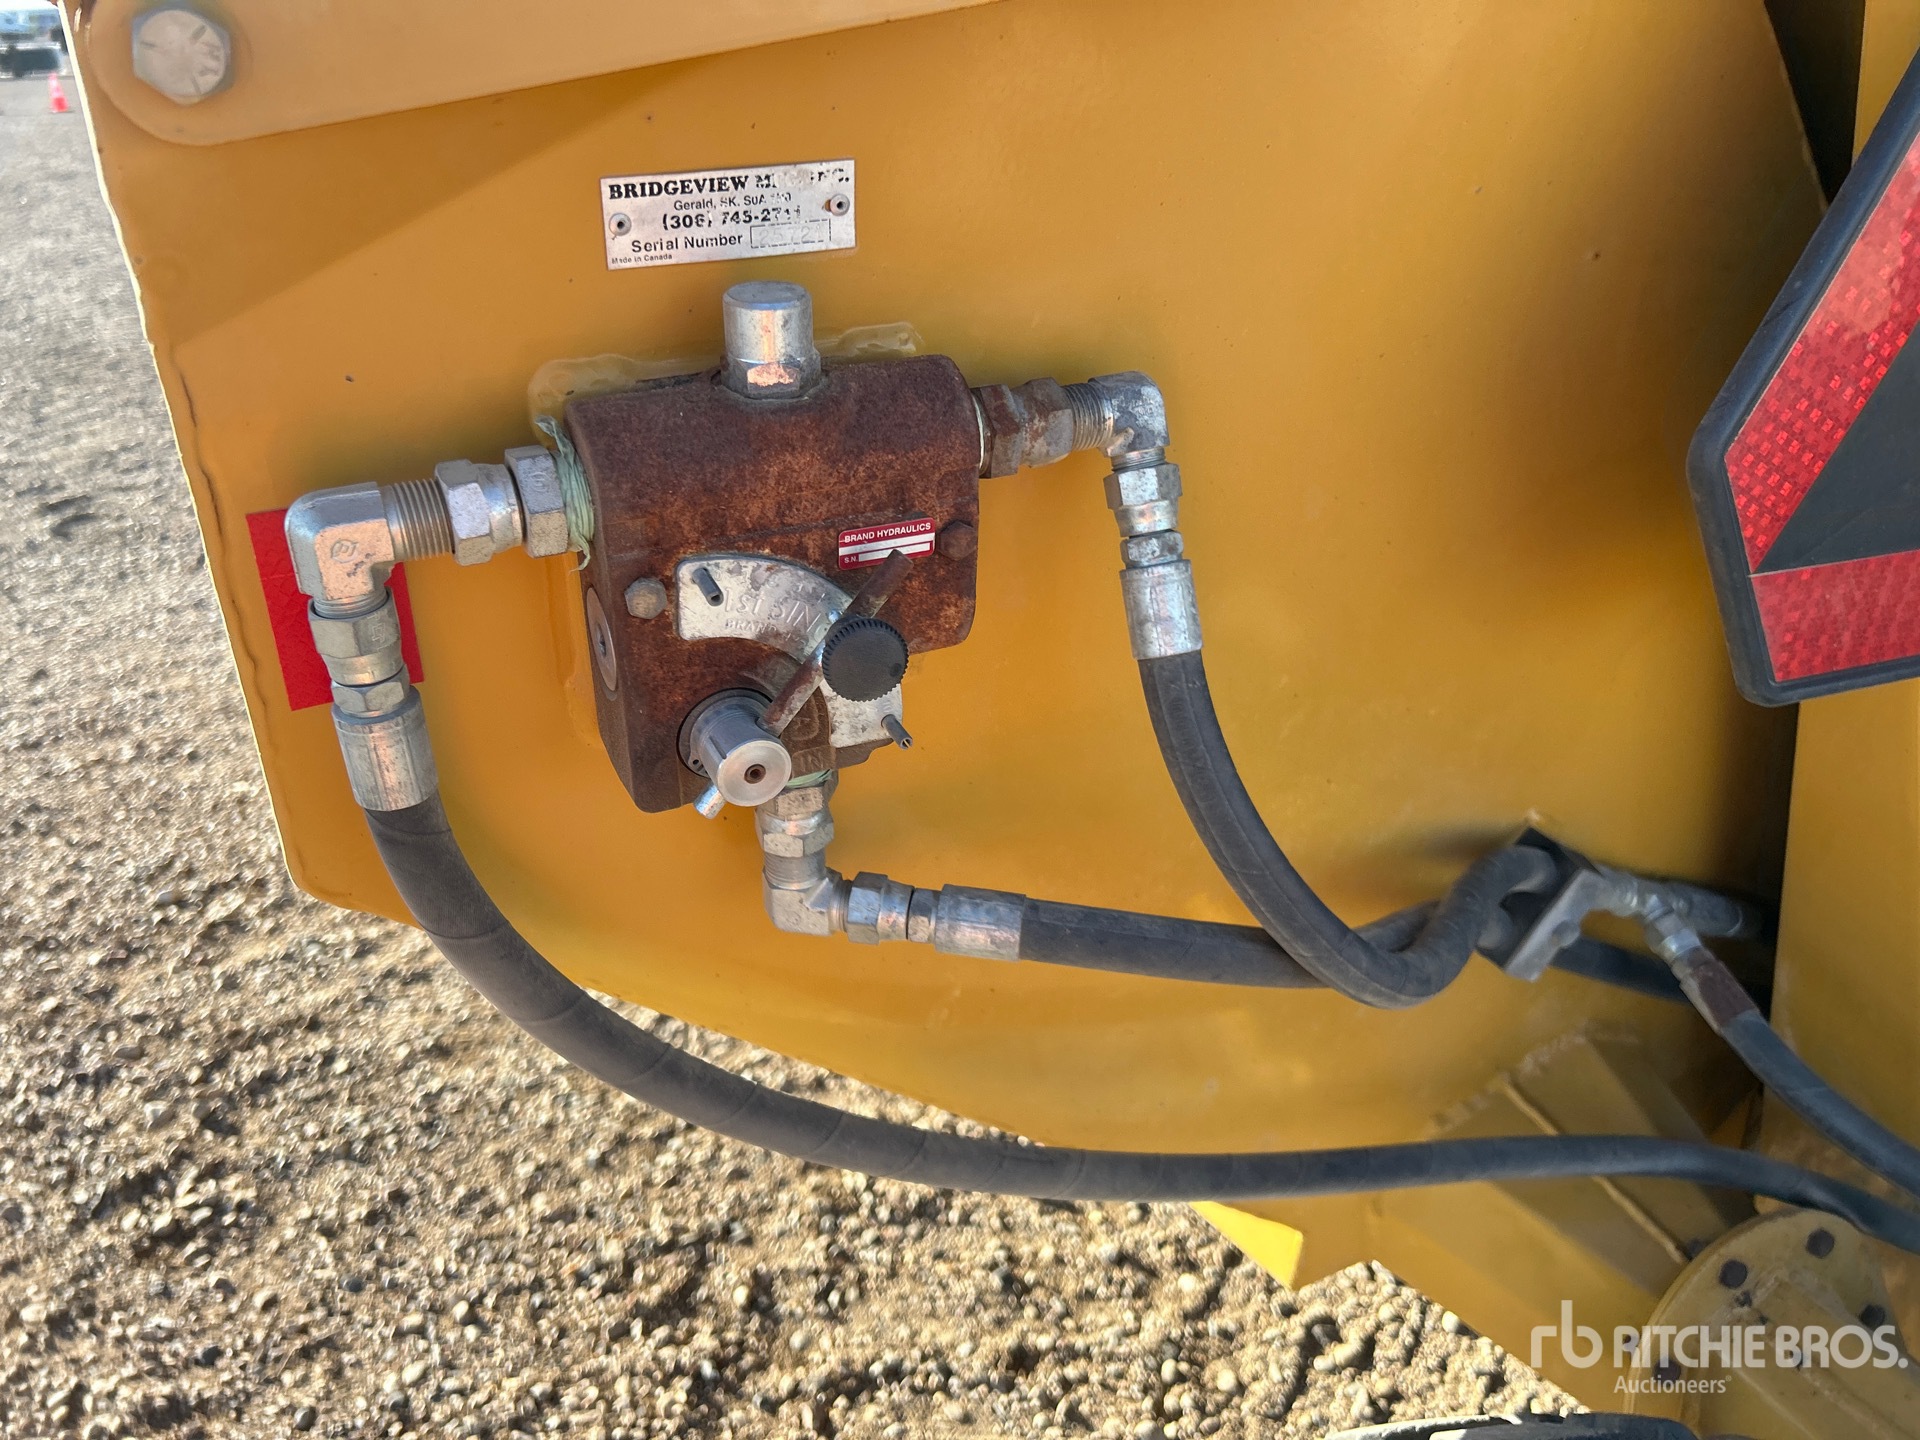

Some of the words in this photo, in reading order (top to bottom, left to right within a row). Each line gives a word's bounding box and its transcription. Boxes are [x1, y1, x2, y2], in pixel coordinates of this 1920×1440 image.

[609, 174, 749, 200] BRIDGEVIEW
[674, 198, 717, 212] Gerald,
[631, 237, 679, 253] Serial
[684, 233, 743, 250] Number
[644, 253, 673, 262] Canada
[844, 531, 875, 543] BRAND
[877, 522, 931, 538] HYDRAULICS
